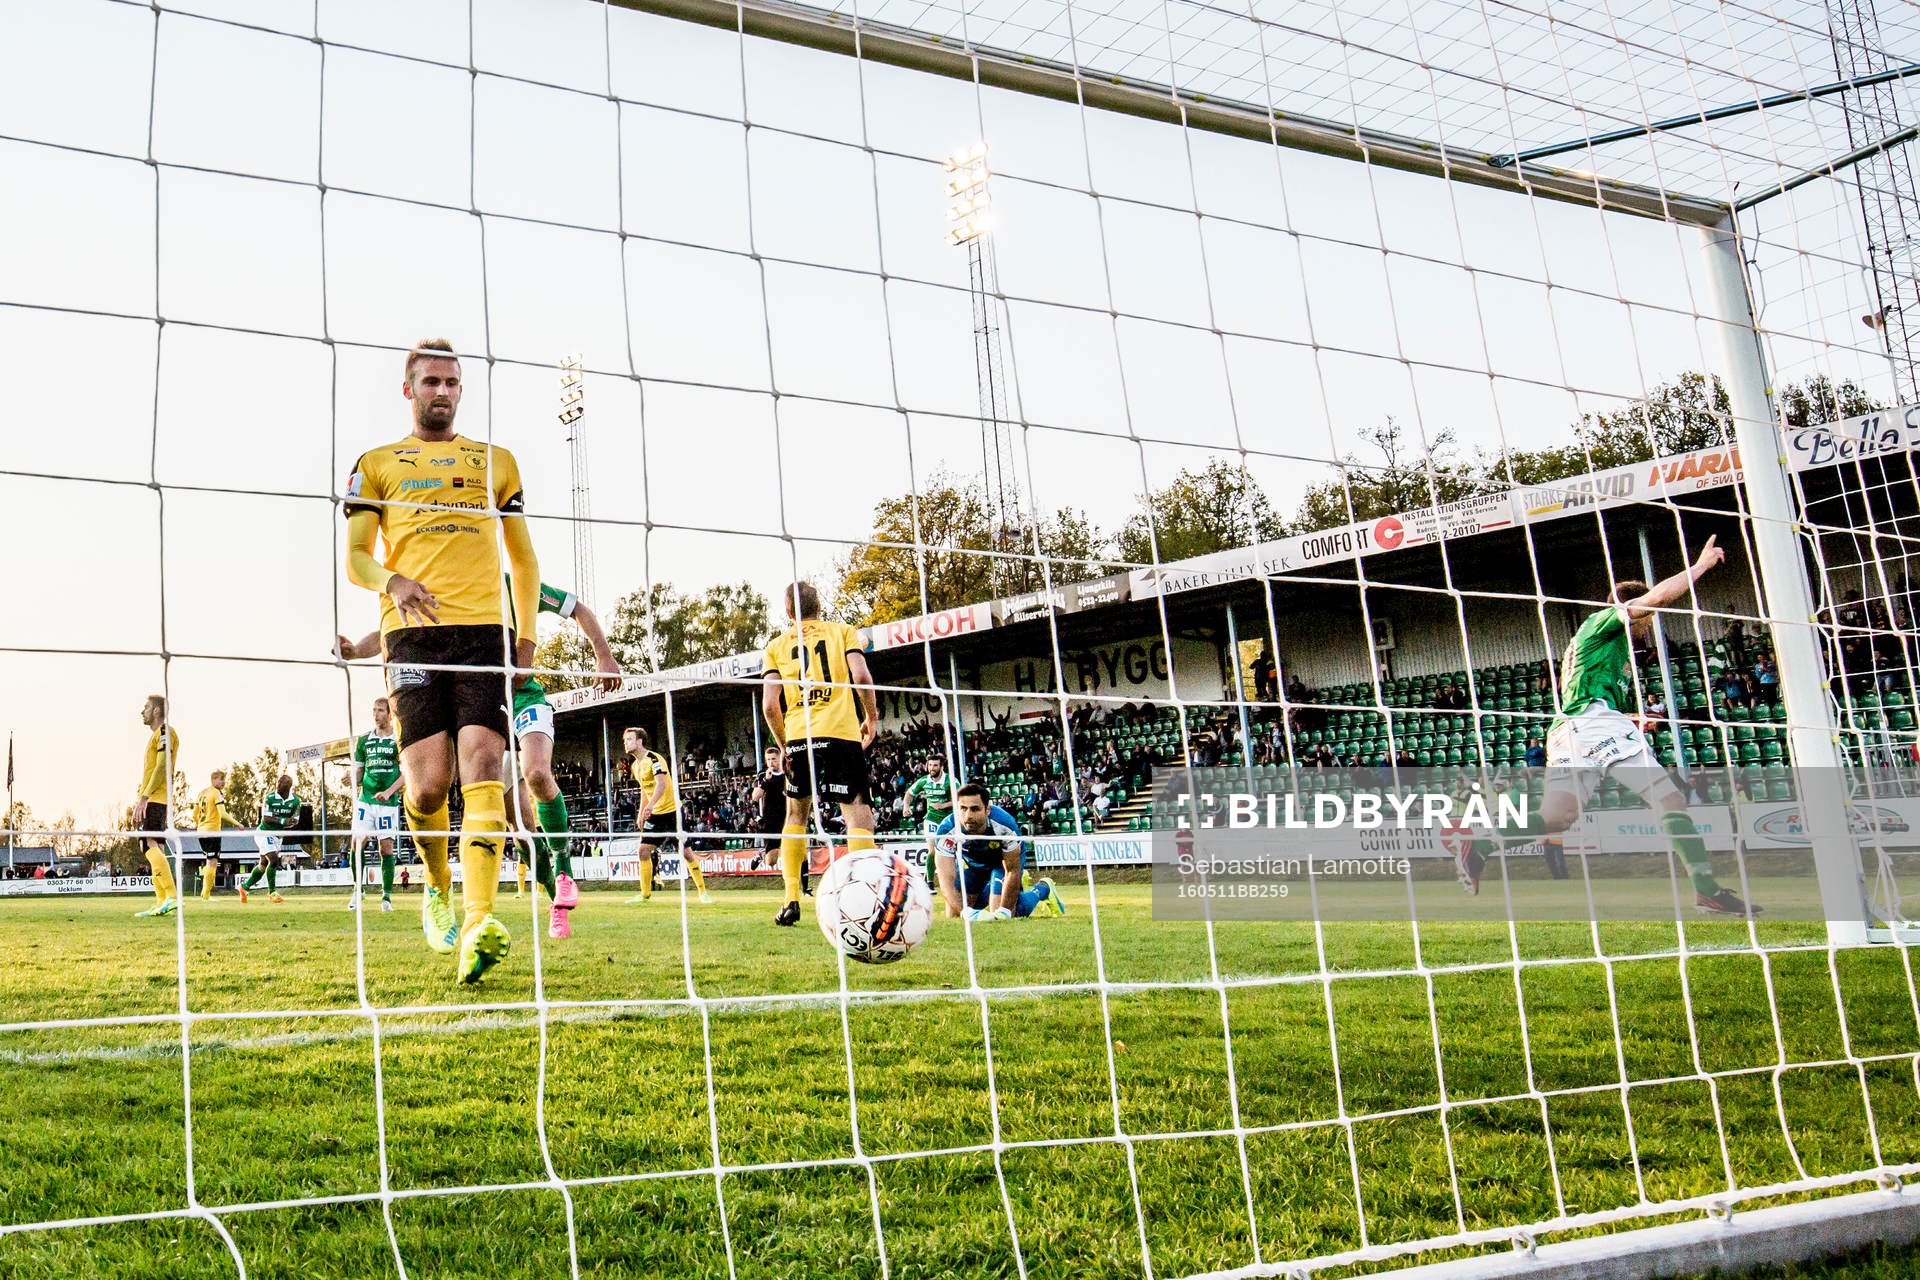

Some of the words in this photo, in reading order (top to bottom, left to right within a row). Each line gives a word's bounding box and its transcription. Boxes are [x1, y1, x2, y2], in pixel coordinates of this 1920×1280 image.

[1563, 472, 1635, 509] ARVID
[1696, 477, 1709, 489] OF
[1165, 573, 1210, 594] BAKER
[1263, 556, 1292, 574] SEK
[886, 607, 976, 646] RICOH
[1014, 609, 1051, 623] Bilservic
[1036, 842, 1143, 862] BOHUSLNINGEN
